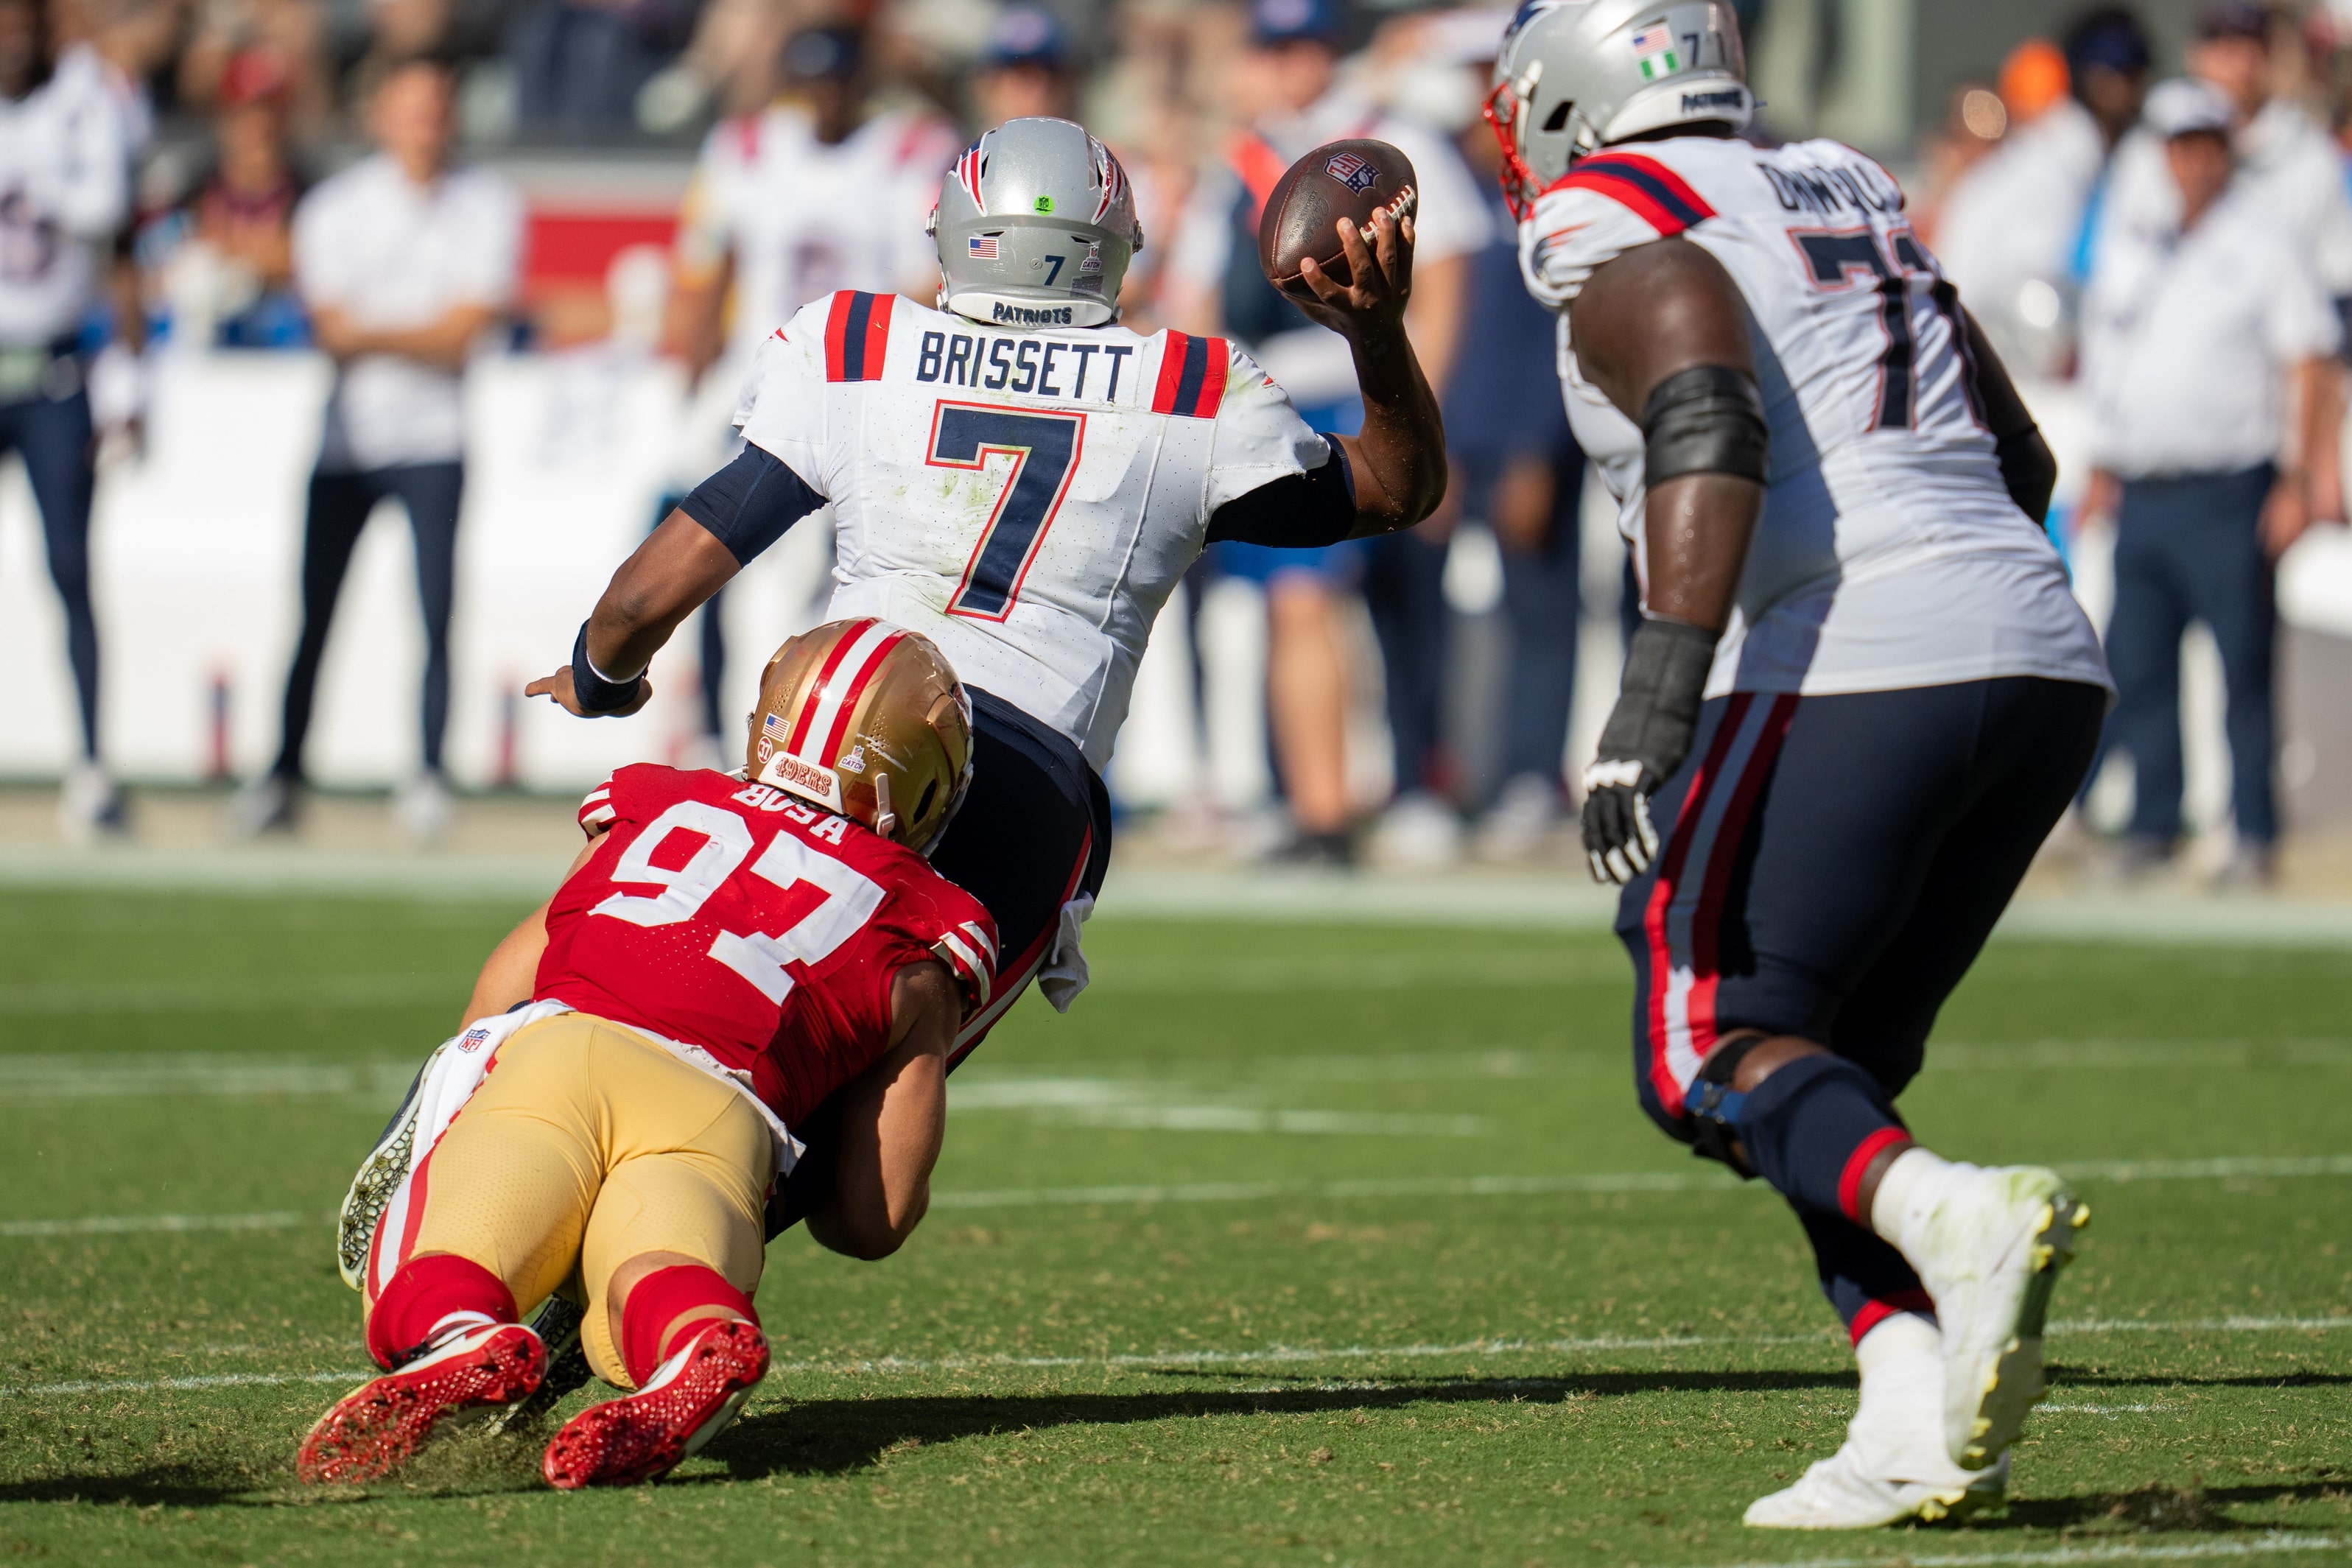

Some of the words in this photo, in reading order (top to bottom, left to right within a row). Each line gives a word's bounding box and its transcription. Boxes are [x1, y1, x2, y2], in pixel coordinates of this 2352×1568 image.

[1328, 154, 1363, 178] NFL
[1044, 255, 1067, 286] 7
[1082, 261, 1101, 269] CATCH
[993, 301, 1072, 325] PATRIOTS
[916, 331, 1133, 403] BRISSETT
[925, 398, 1087, 624] 7
[759, 740, 771, 761] 37
[841, 758, 865, 770] CATCH
[776, 757, 833, 798] 49ERS
[731, 784, 849, 846] BOSA
[587, 800, 886, 1008] 97
